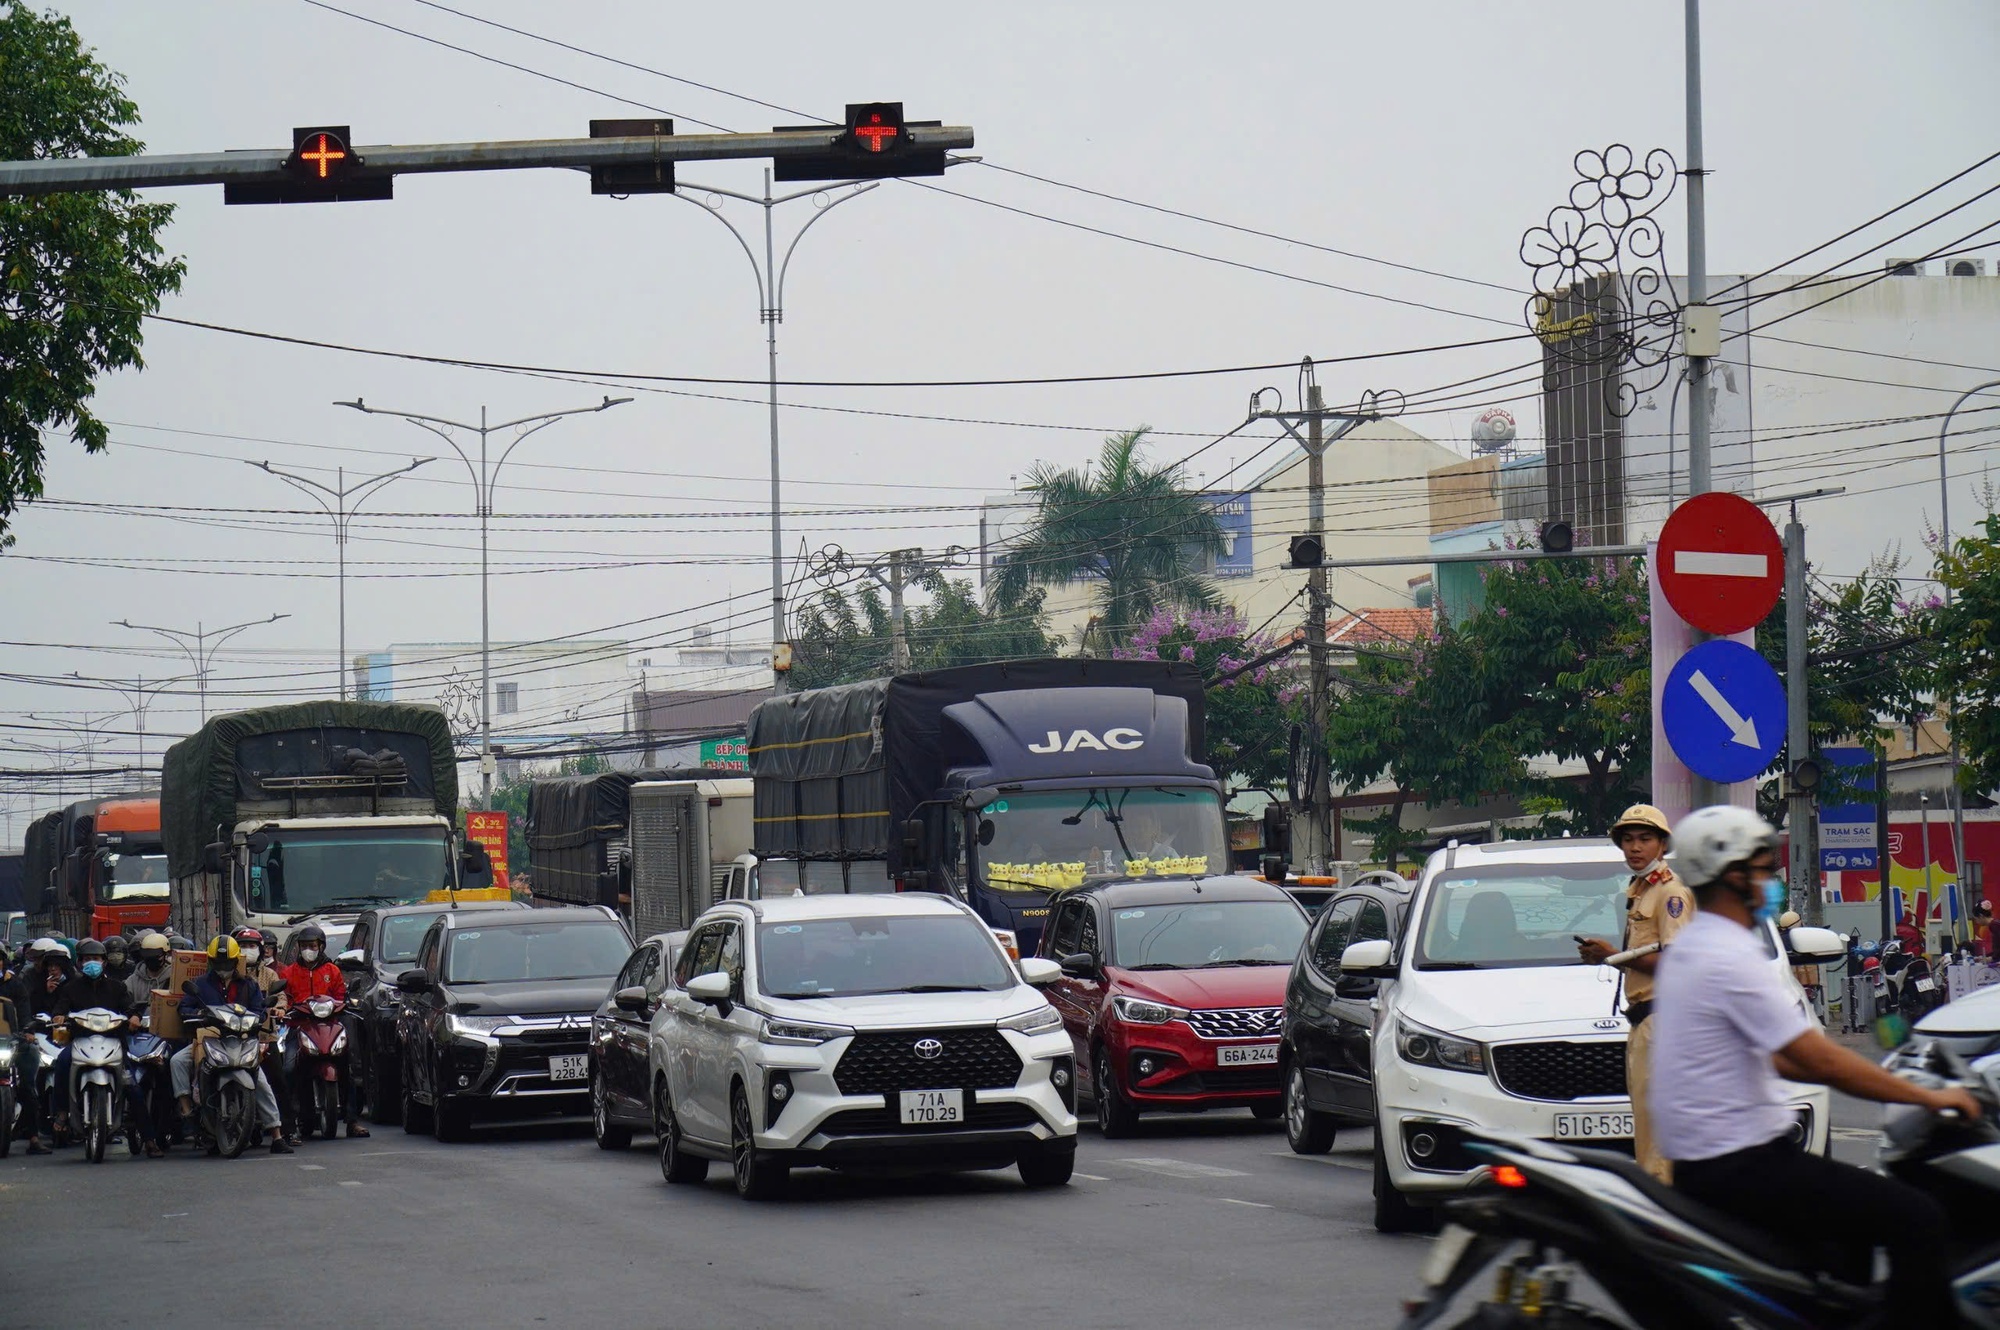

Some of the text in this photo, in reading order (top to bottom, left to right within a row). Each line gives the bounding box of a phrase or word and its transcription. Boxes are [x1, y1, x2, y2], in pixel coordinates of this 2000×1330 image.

[1028, 727, 1144, 754] JAC
[716, 741, 733, 755] BẾP
[1825, 827, 1871, 837] TRẠM SẠC
[1596, 1020, 1618, 1028] KIA
[563, 1056, 582, 1068] 51K
[918, 1092, 945, 1107] 71A
[909, 1107, 957, 1122] 170.29
